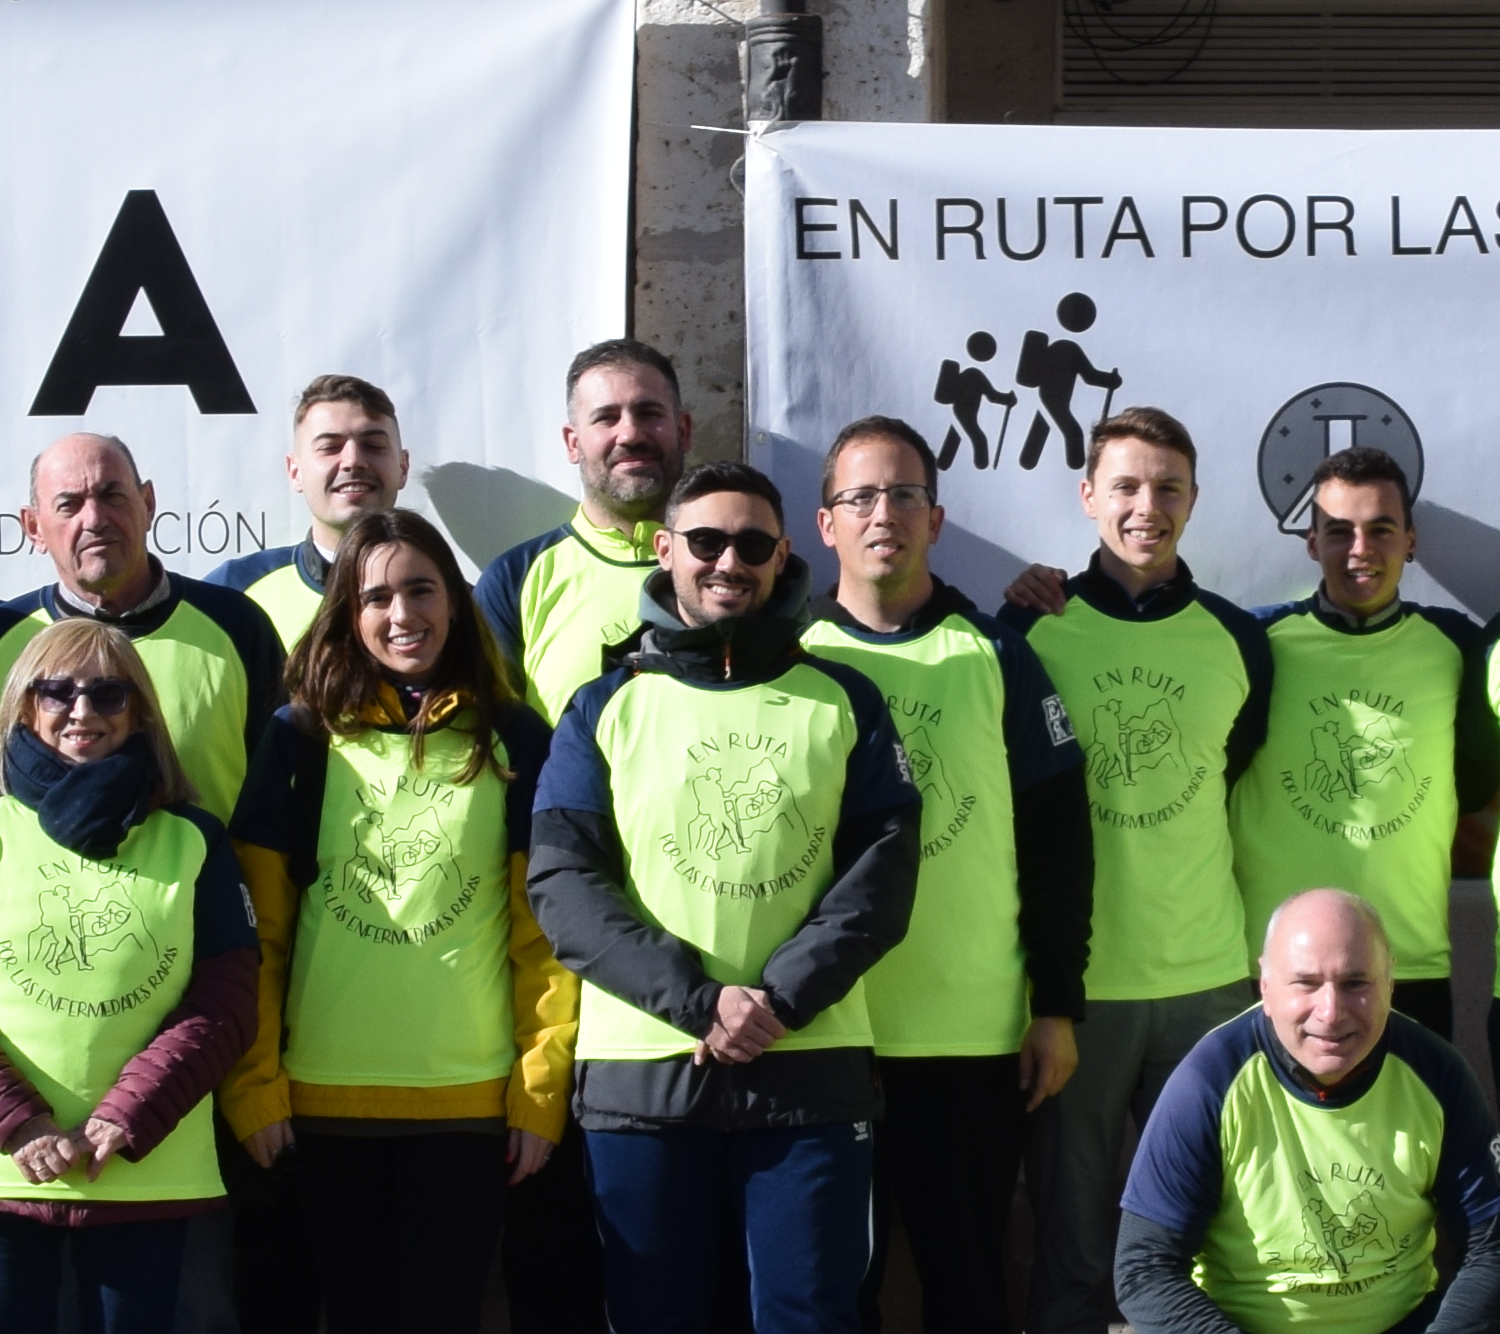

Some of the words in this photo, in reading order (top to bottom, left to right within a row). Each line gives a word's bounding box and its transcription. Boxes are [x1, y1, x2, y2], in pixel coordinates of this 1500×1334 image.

[795, 197, 900, 262] EN
[936, 195, 1155, 262] RUTA
[1182, 193, 1356, 259] POR
[1094, 668, 1123, 693] EN
[1132, 666, 1187, 702] RUTA
[1309, 693, 1340, 716] EN
[1349, 689, 1404, 717] RUTA
[687, 736, 720, 763] EN
[729, 732, 788, 759] RUTA
[356, 780, 387, 806] EN
[396, 775, 455, 808] RUTA
[1183, 765, 1207, 806] RARAS
[1279, 770, 1297, 796] POR
[1292, 794, 1315, 821] LAS
[1408, 775, 1433, 814] RARAS
[948, 794, 977, 838] RARAS
[38, 860, 70, 881] EN
[81, 857, 140, 882] RUTA
[658, 832, 680, 863] POR
[674, 860, 702, 888] LAS
[700, 865, 807, 900] ENFERMEDADES
[803, 825, 826, 869] RARAS
[324, 896, 349, 922] LAS
[347, 912, 455, 946] ENFERMEDADES
[454, 874, 482, 918] RARAS
[11, 968, 39, 996] LAS
[35, 984, 151, 1018] ENFERMEDADES
[148, 945, 179, 990] RARAS
[1331, 1162, 1387, 1191] RUTA
